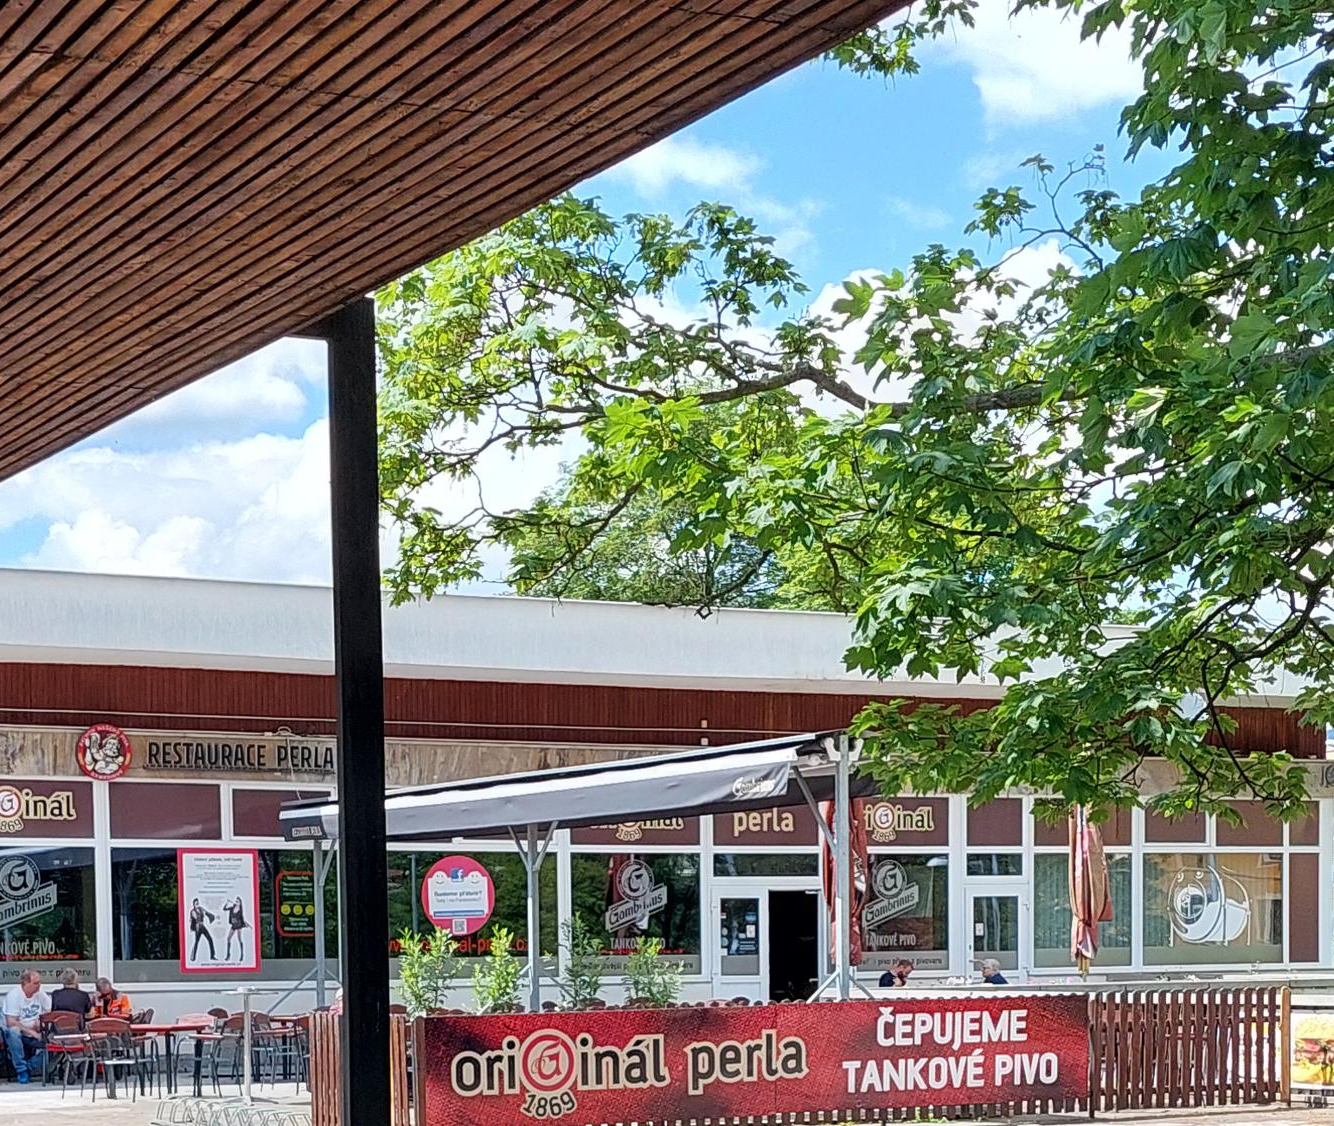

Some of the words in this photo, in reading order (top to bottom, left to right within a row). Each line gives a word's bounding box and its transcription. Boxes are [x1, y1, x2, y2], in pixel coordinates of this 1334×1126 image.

[148, 741, 266, 767] RESTAURACE
[277, 745, 334, 769] PERLA
[733, 807, 795, 837] perla
[871, 829, 897, 842] 1869
[866, 891, 916, 923] Gambrinus
[32, 941, 56, 955] PIVO
[899, 933, 916, 947] PIVO
[877, 1007, 1028, 1051] ČEPUJEME
[684, 1029, 807, 1095] perla
[842, 1048, 984, 1094] TANKOVÉ
[994, 1052, 1058, 1087] PIVO
[519, 1090, 576, 1119] 1869
